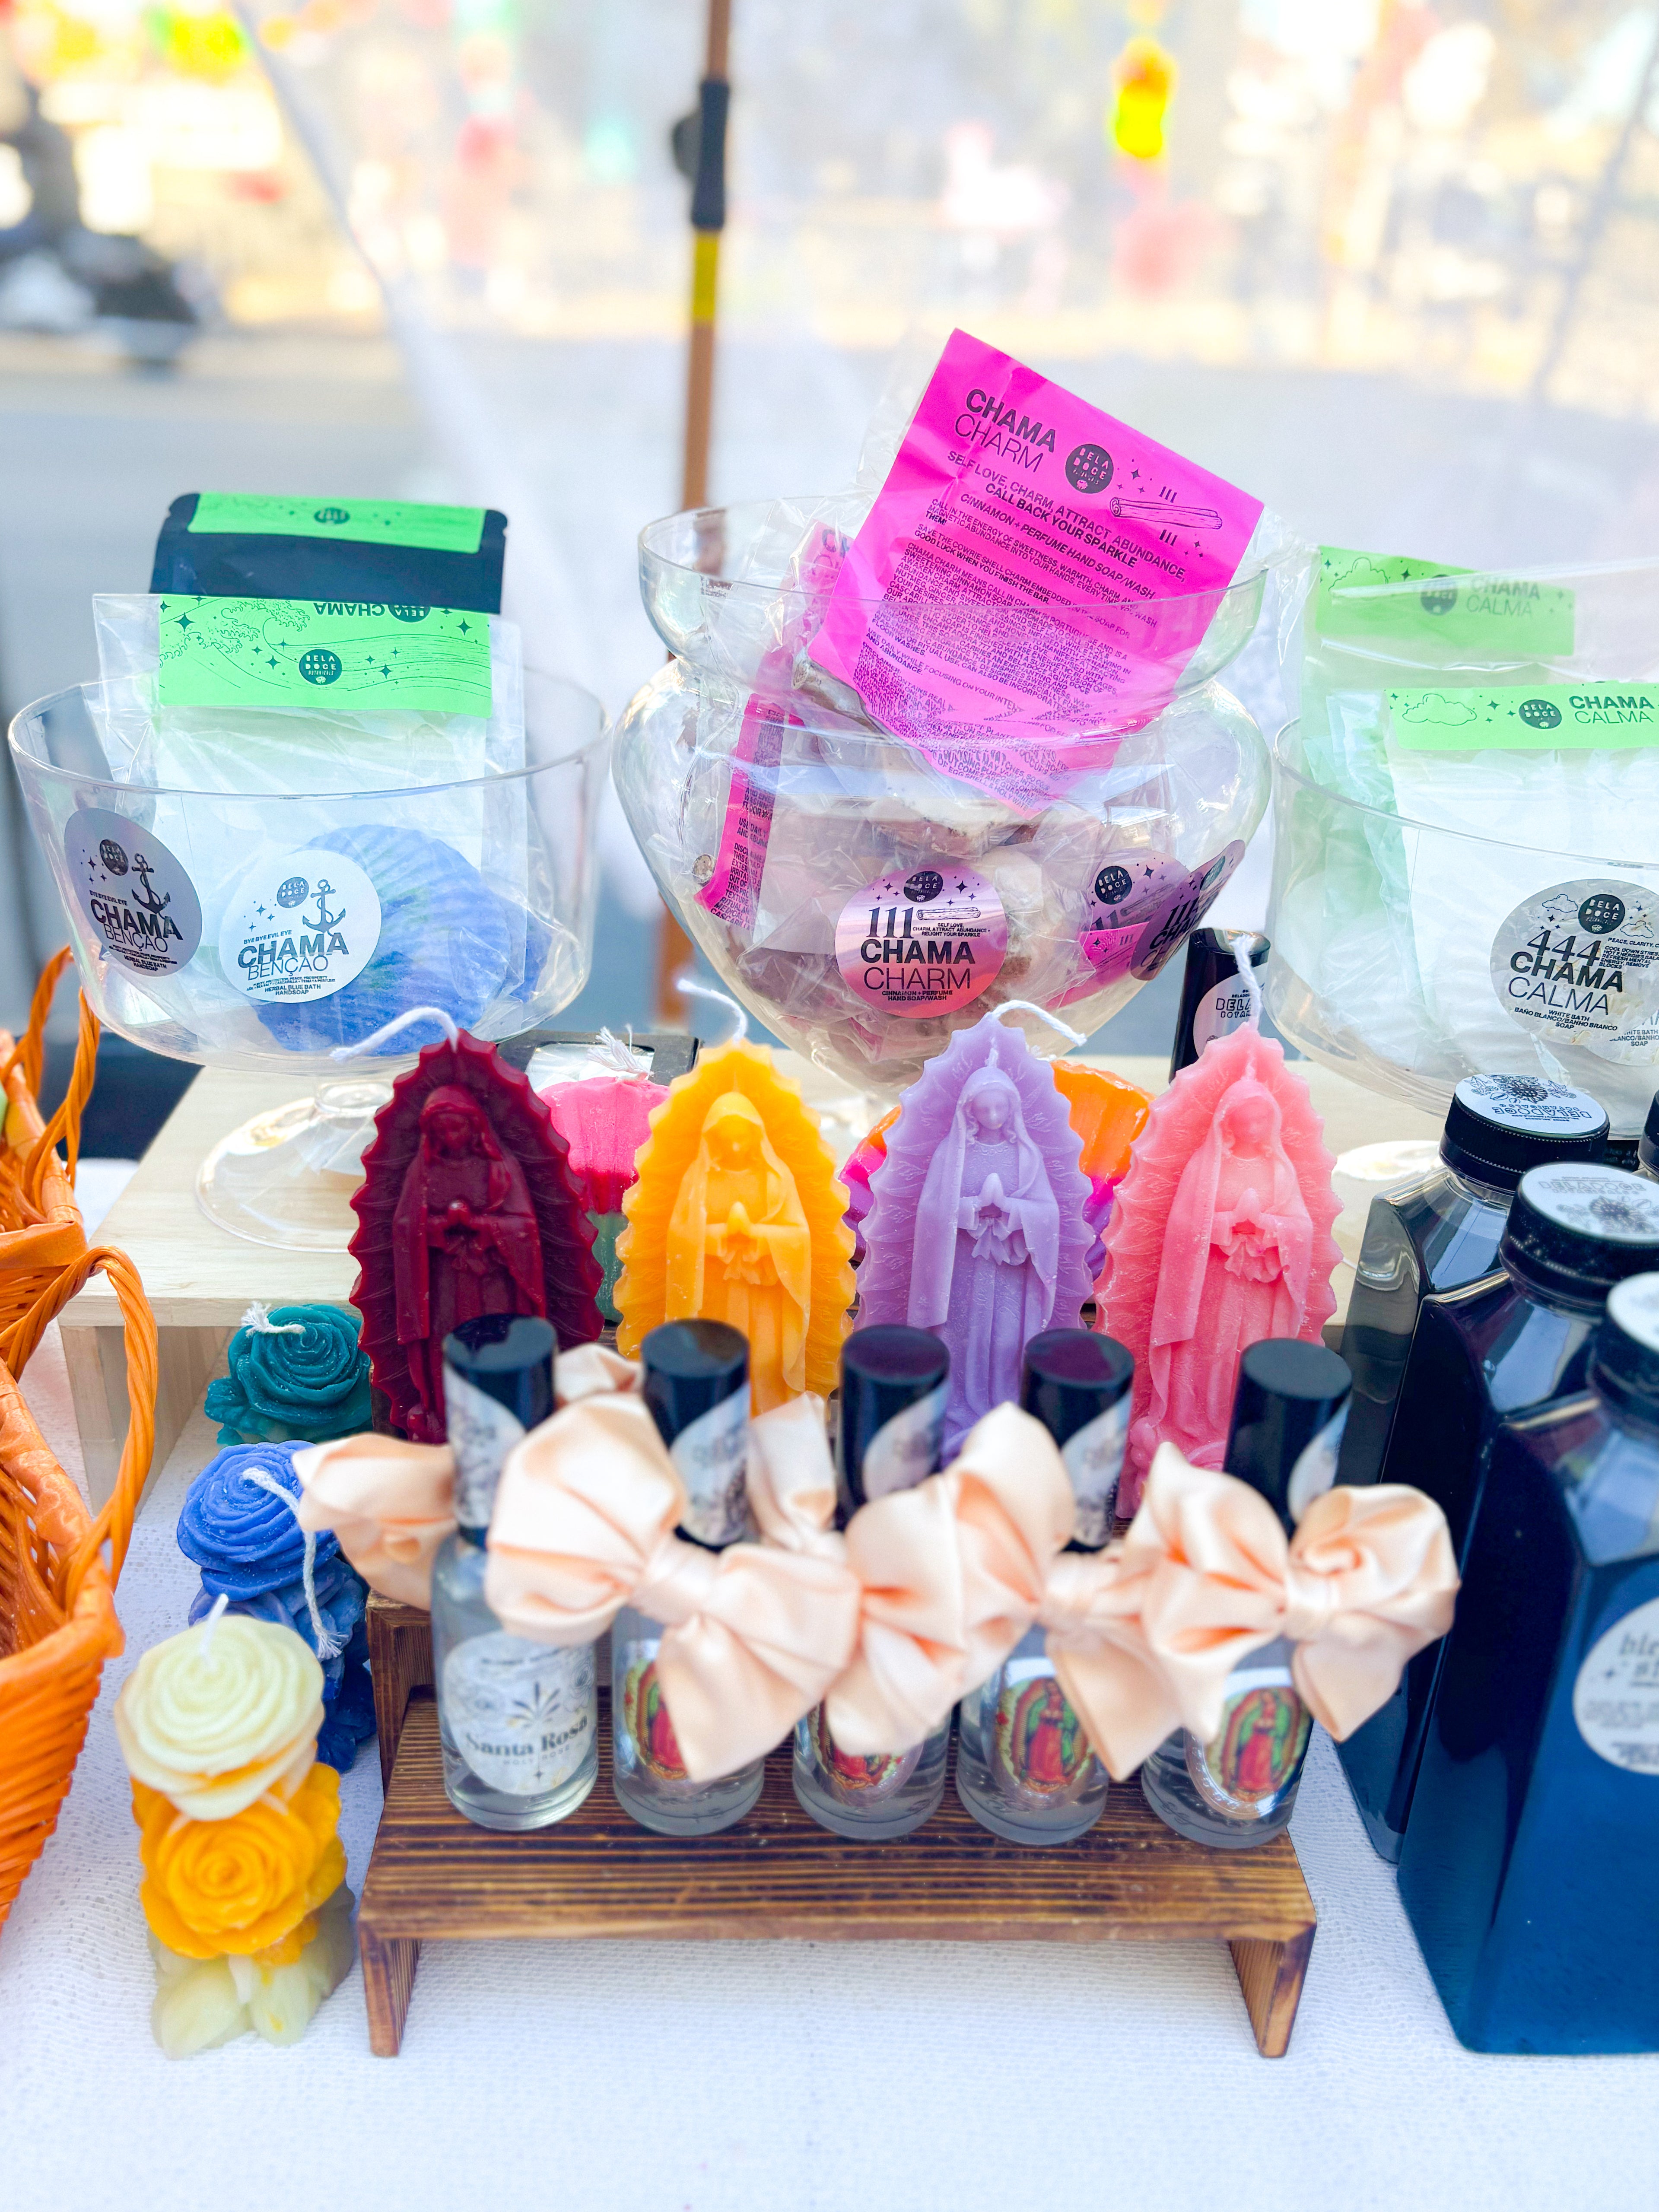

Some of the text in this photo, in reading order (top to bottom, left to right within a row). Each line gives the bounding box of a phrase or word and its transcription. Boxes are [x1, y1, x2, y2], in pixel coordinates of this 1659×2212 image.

[965, 388, 1057, 454] CHAMA
[953, 413, 1045, 474] CHARM
[1078, 447, 1111, 469] BELA
[1072, 456, 1107, 480] DOCE
[924, 510, 947, 526] THEM!
[946, 448, 1189, 583] SELF LOVE, CHARM, ATTRACT ABUNDANCE,
[984, 481, 1138, 568] CALL BACK YOUR SPARKLE
[928, 504, 966, 528] MAGNETIC
[964, 522, 1011, 551] ABUNDANCE
[1009, 546, 1029, 560] INTO
[1027, 555, 1050, 571] YOUR
[1047, 566, 1077, 587] HANDS,
[1076, 581, 1102, 598] EVERY
[931, 497, 949, 511] CALL
[948, 506, 958, 515] IN
[957, 510, 973, 523] THE
[972, 518, 1004, 539] ENERGY
[1002, 533, 1014, 544] OF
[1058, 563, 1095, 587] WARMTH,
[1092, 581, 1122, 601] CHARM,
[959, 492, 1016, 526] CINNAMON
[1019, 522, 1068, 554] PERFUME
[1065, 547, 1097, 569] HAND
[1093, 562, 1156, 600] SOAP/WASH
[891, 574, 913, 589] YOUR
[897, 561, 960, 598] ABUNDANCE AND
[913, 529, 1051, 605] GOOD LUCK WHEN YOU FINISH THE BAR.
[917, 523, 1072, 607] SAVE THE COWRIE SHELL CHARM EMBEDDED
[903, 548, 953, 578] SWEETENING
[951, 573, 992, 599] CINNAMON
[1053, 627, 1065, 637] TO
[932, 572, 963, 592] CHARM,
[1026, 620, 1045, 634] SELF
[934, 556, 962, 575] CHARM
[960, 569, 988, 588] MEANS
[986, 583, 1006, 598] CALL
[1005, 593, 1015, 603] IN
[1097, 642, 1114, 654] AND
[1466, 595, 1533, 617] CALMA
[314, 603, 385, 616] CHAMA
[1569, 695, 1655, 710] CHAMA
[1574, 711, 1654, 724] CALMA
[281, 887, 305, 897] DOCE
[282, 881, 305, 890] BELA
[1098, 870, 1123, 887] BELA
[1100, 879, 1127, 894] DOCE
[91, 899, 183, 941] CHAMA
[1585, 909, 1619, 920] DOCE
[1589, 899, 1620, 911] BELA
[866, 906, 915, 939] 111
[238, 932, 350, 969] CHAMA
[860, 939, 976, 964] CHAMA
[1527, 930, 1602, 967] 444
[864, 966, 970, 990] CHARM
[1510, 951, 1623, 992] CHAMA
[1508, 977, 1609, 1015] CALMA
[1514, 1006, 1618, 1031] BAÑO BLANCO/BANHO BRANCO
[1549, 1010, 1590, 1022] WHITE BATH
[1555, 1021, 1575, 1030] SOAP
[466, 1715, 588, 1756] Santa Rosa
